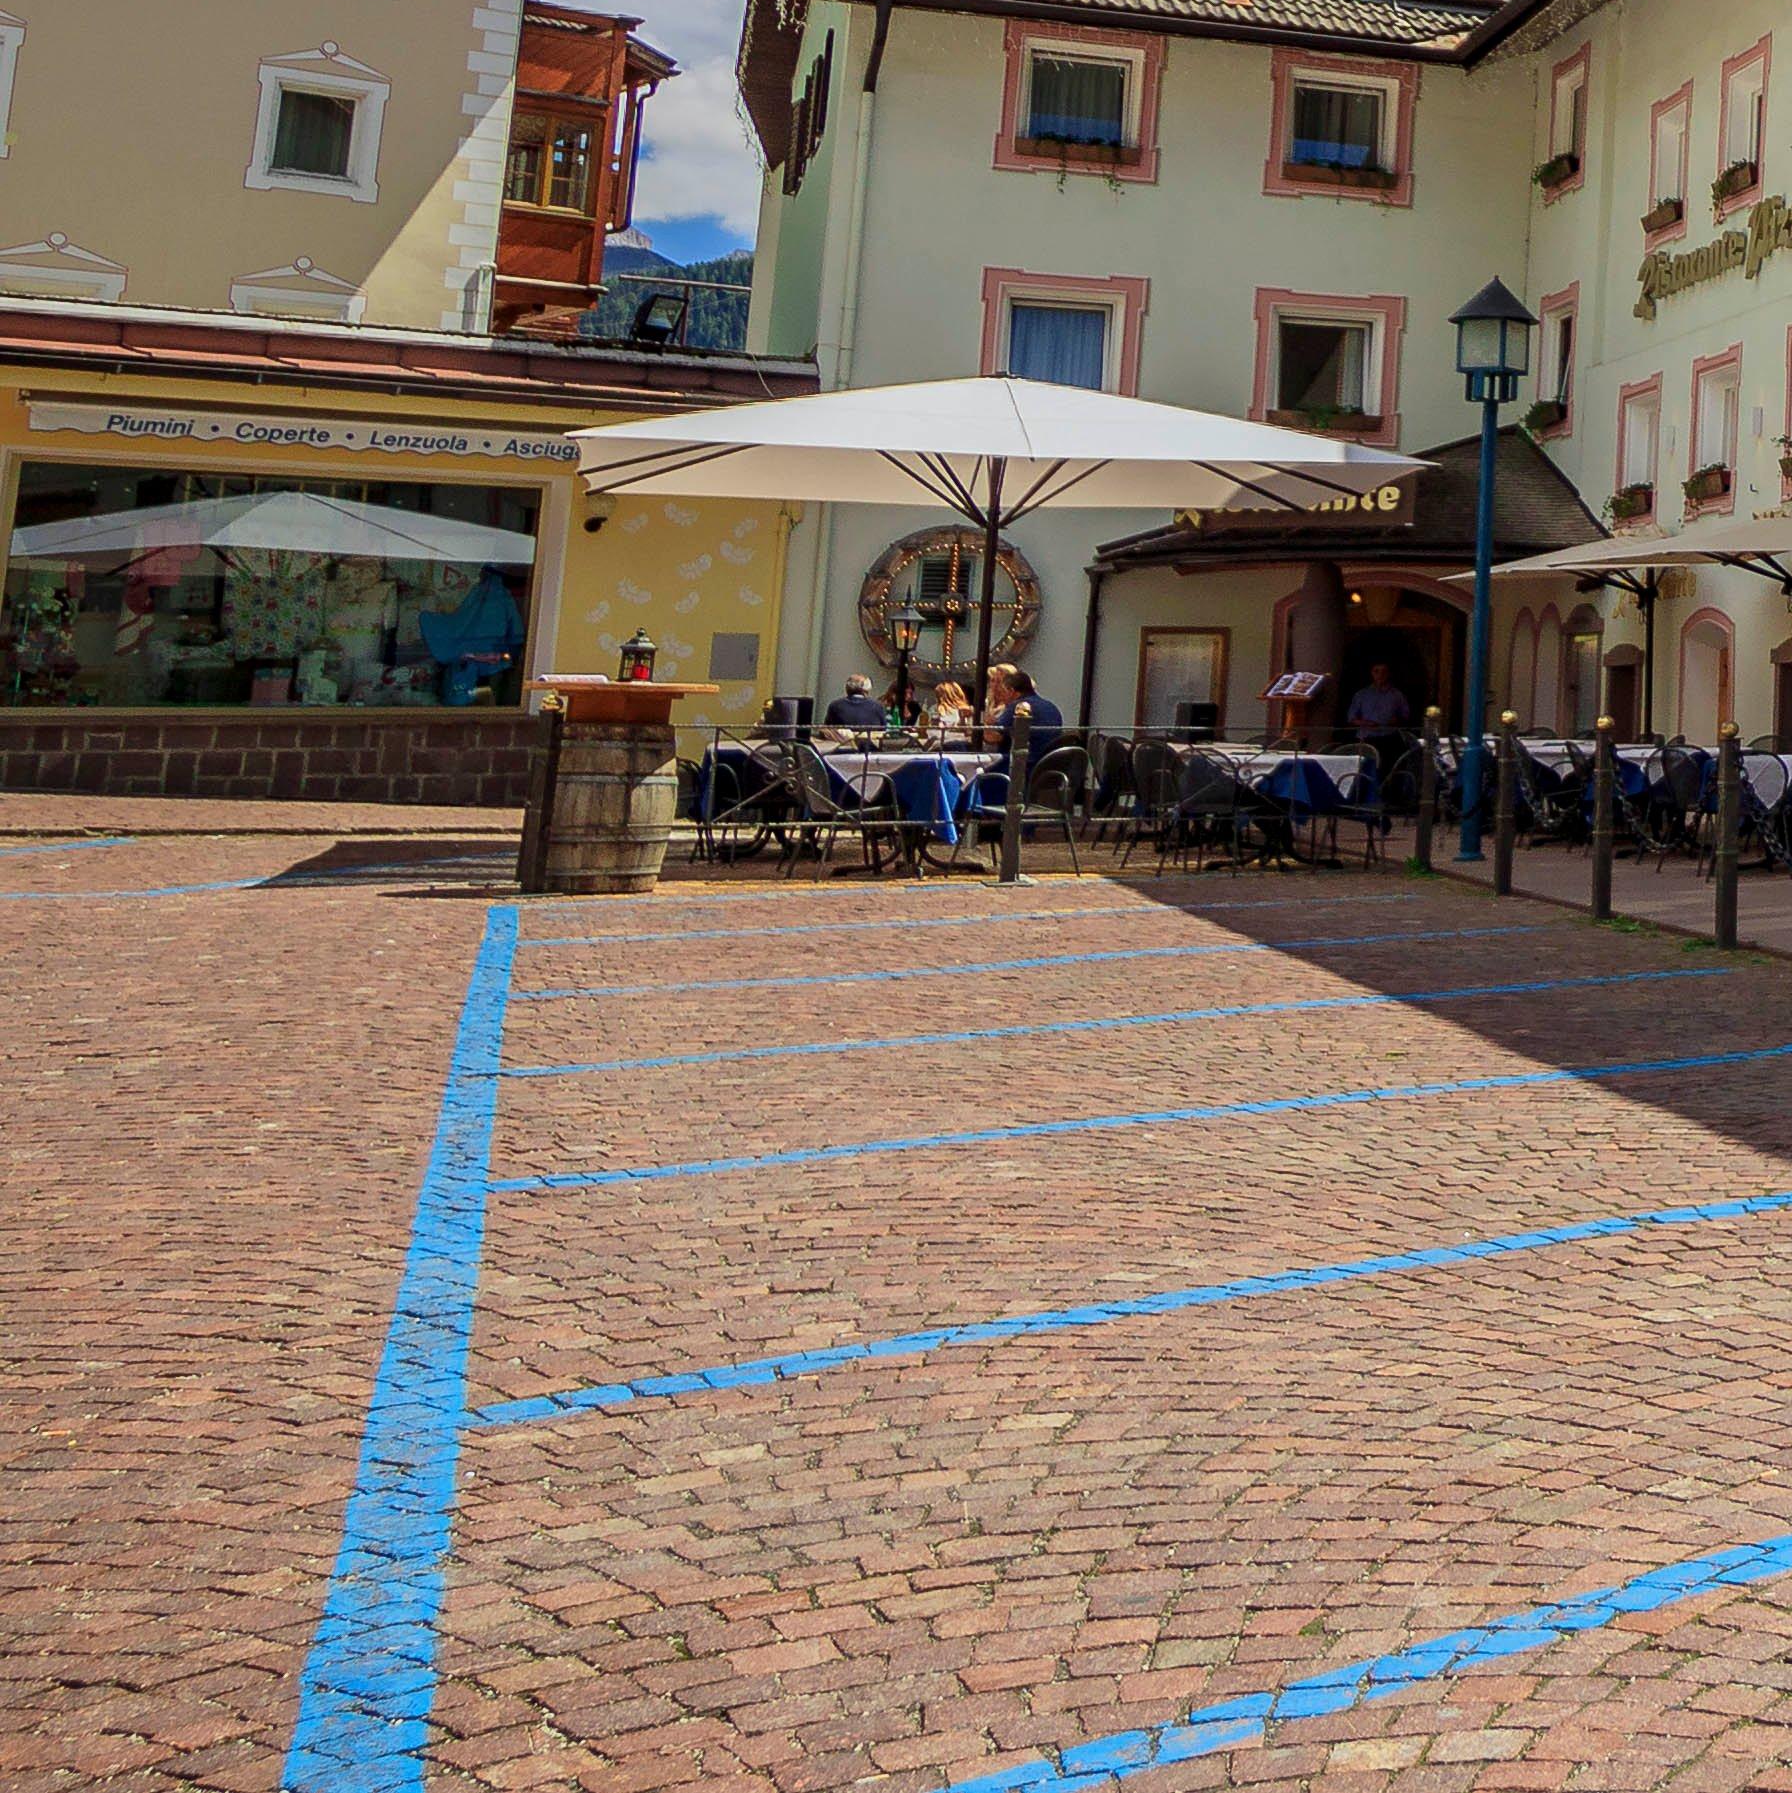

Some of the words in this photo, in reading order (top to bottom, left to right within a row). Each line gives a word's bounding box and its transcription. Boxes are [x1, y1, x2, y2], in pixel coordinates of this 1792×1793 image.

[106, 414, 195, 436] Piumini
[235, 422, 331, 446] Coperte
[370, 430, 467, 451] Lenzuola
